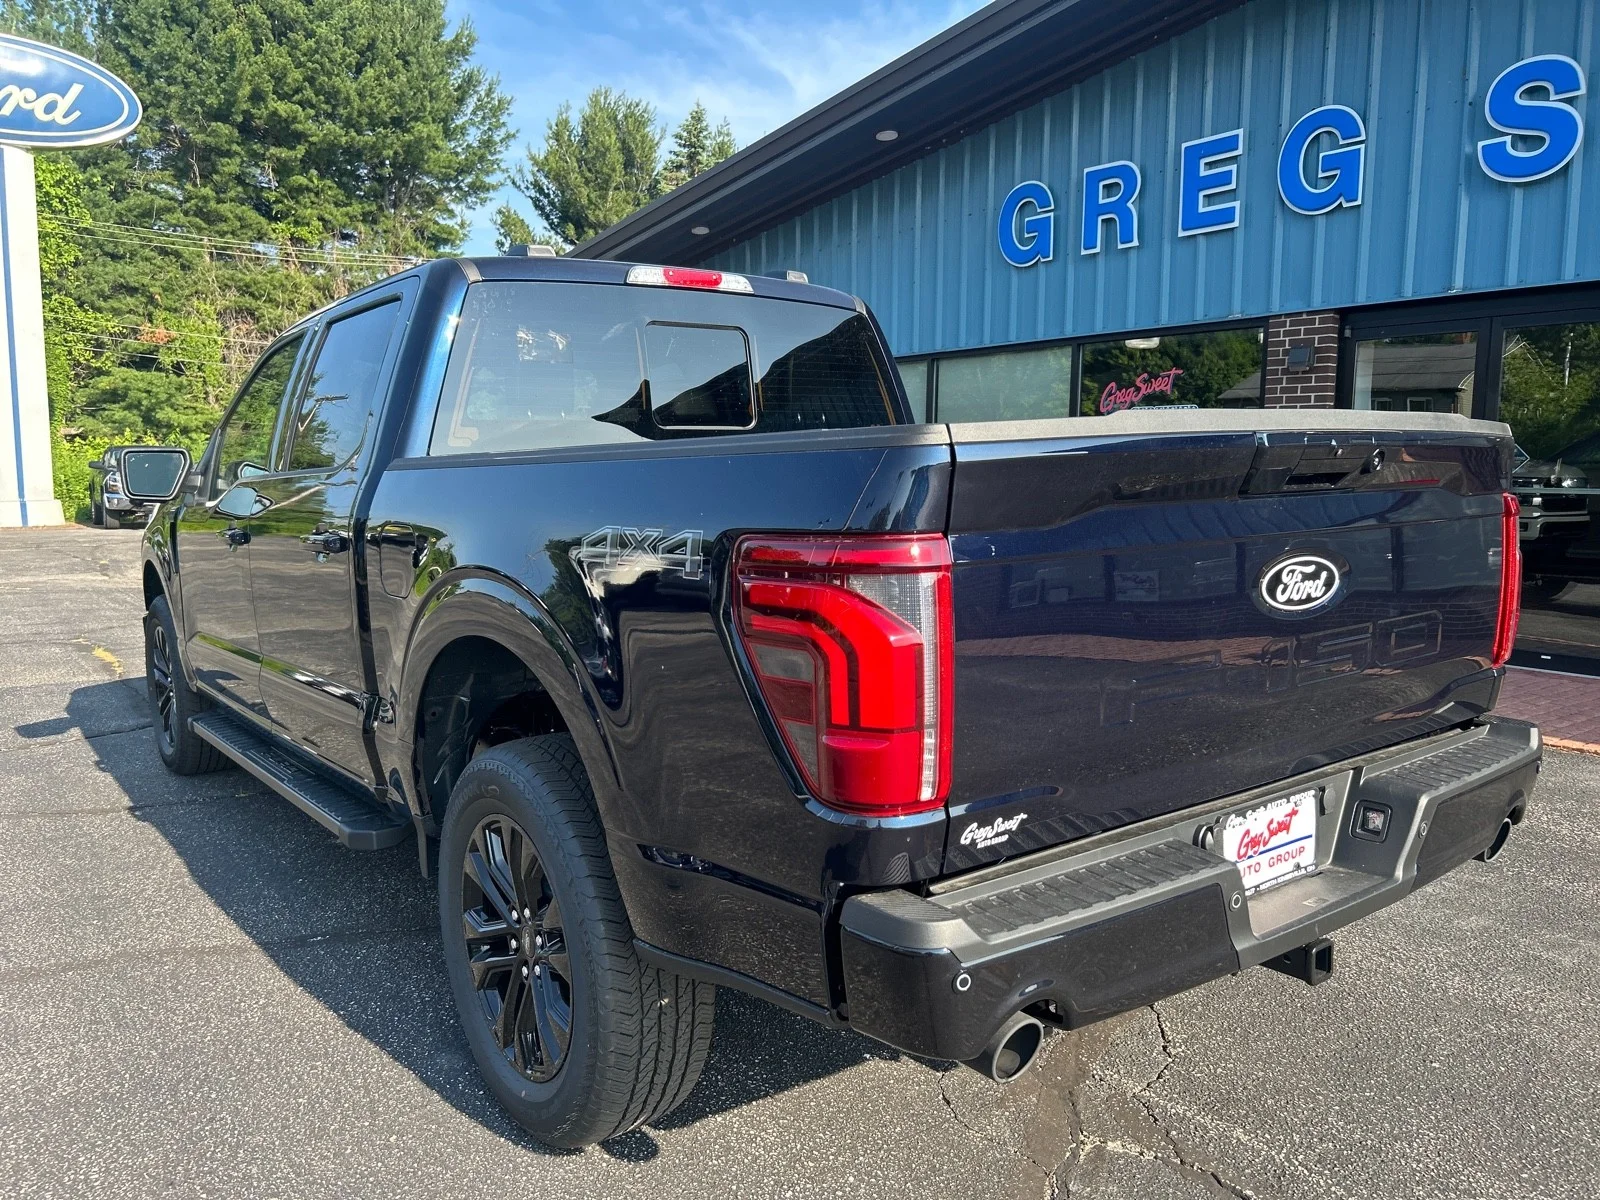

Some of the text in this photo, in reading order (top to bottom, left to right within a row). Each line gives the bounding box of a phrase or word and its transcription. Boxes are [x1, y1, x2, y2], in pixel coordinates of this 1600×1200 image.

[998, 55, 1586, 267] GREG S
[1100, 367, 1183, 413] Greg Sweet
[1276, 564, 1327, 602] Ford
[1267, 798, 1287, 810] AUTO
[960, 813, 1028, 845] Greg Sweet
[1237, 807, 1299, 860] Greg Sweet
[1241, 846, 1305, 878] UTO GROUP
